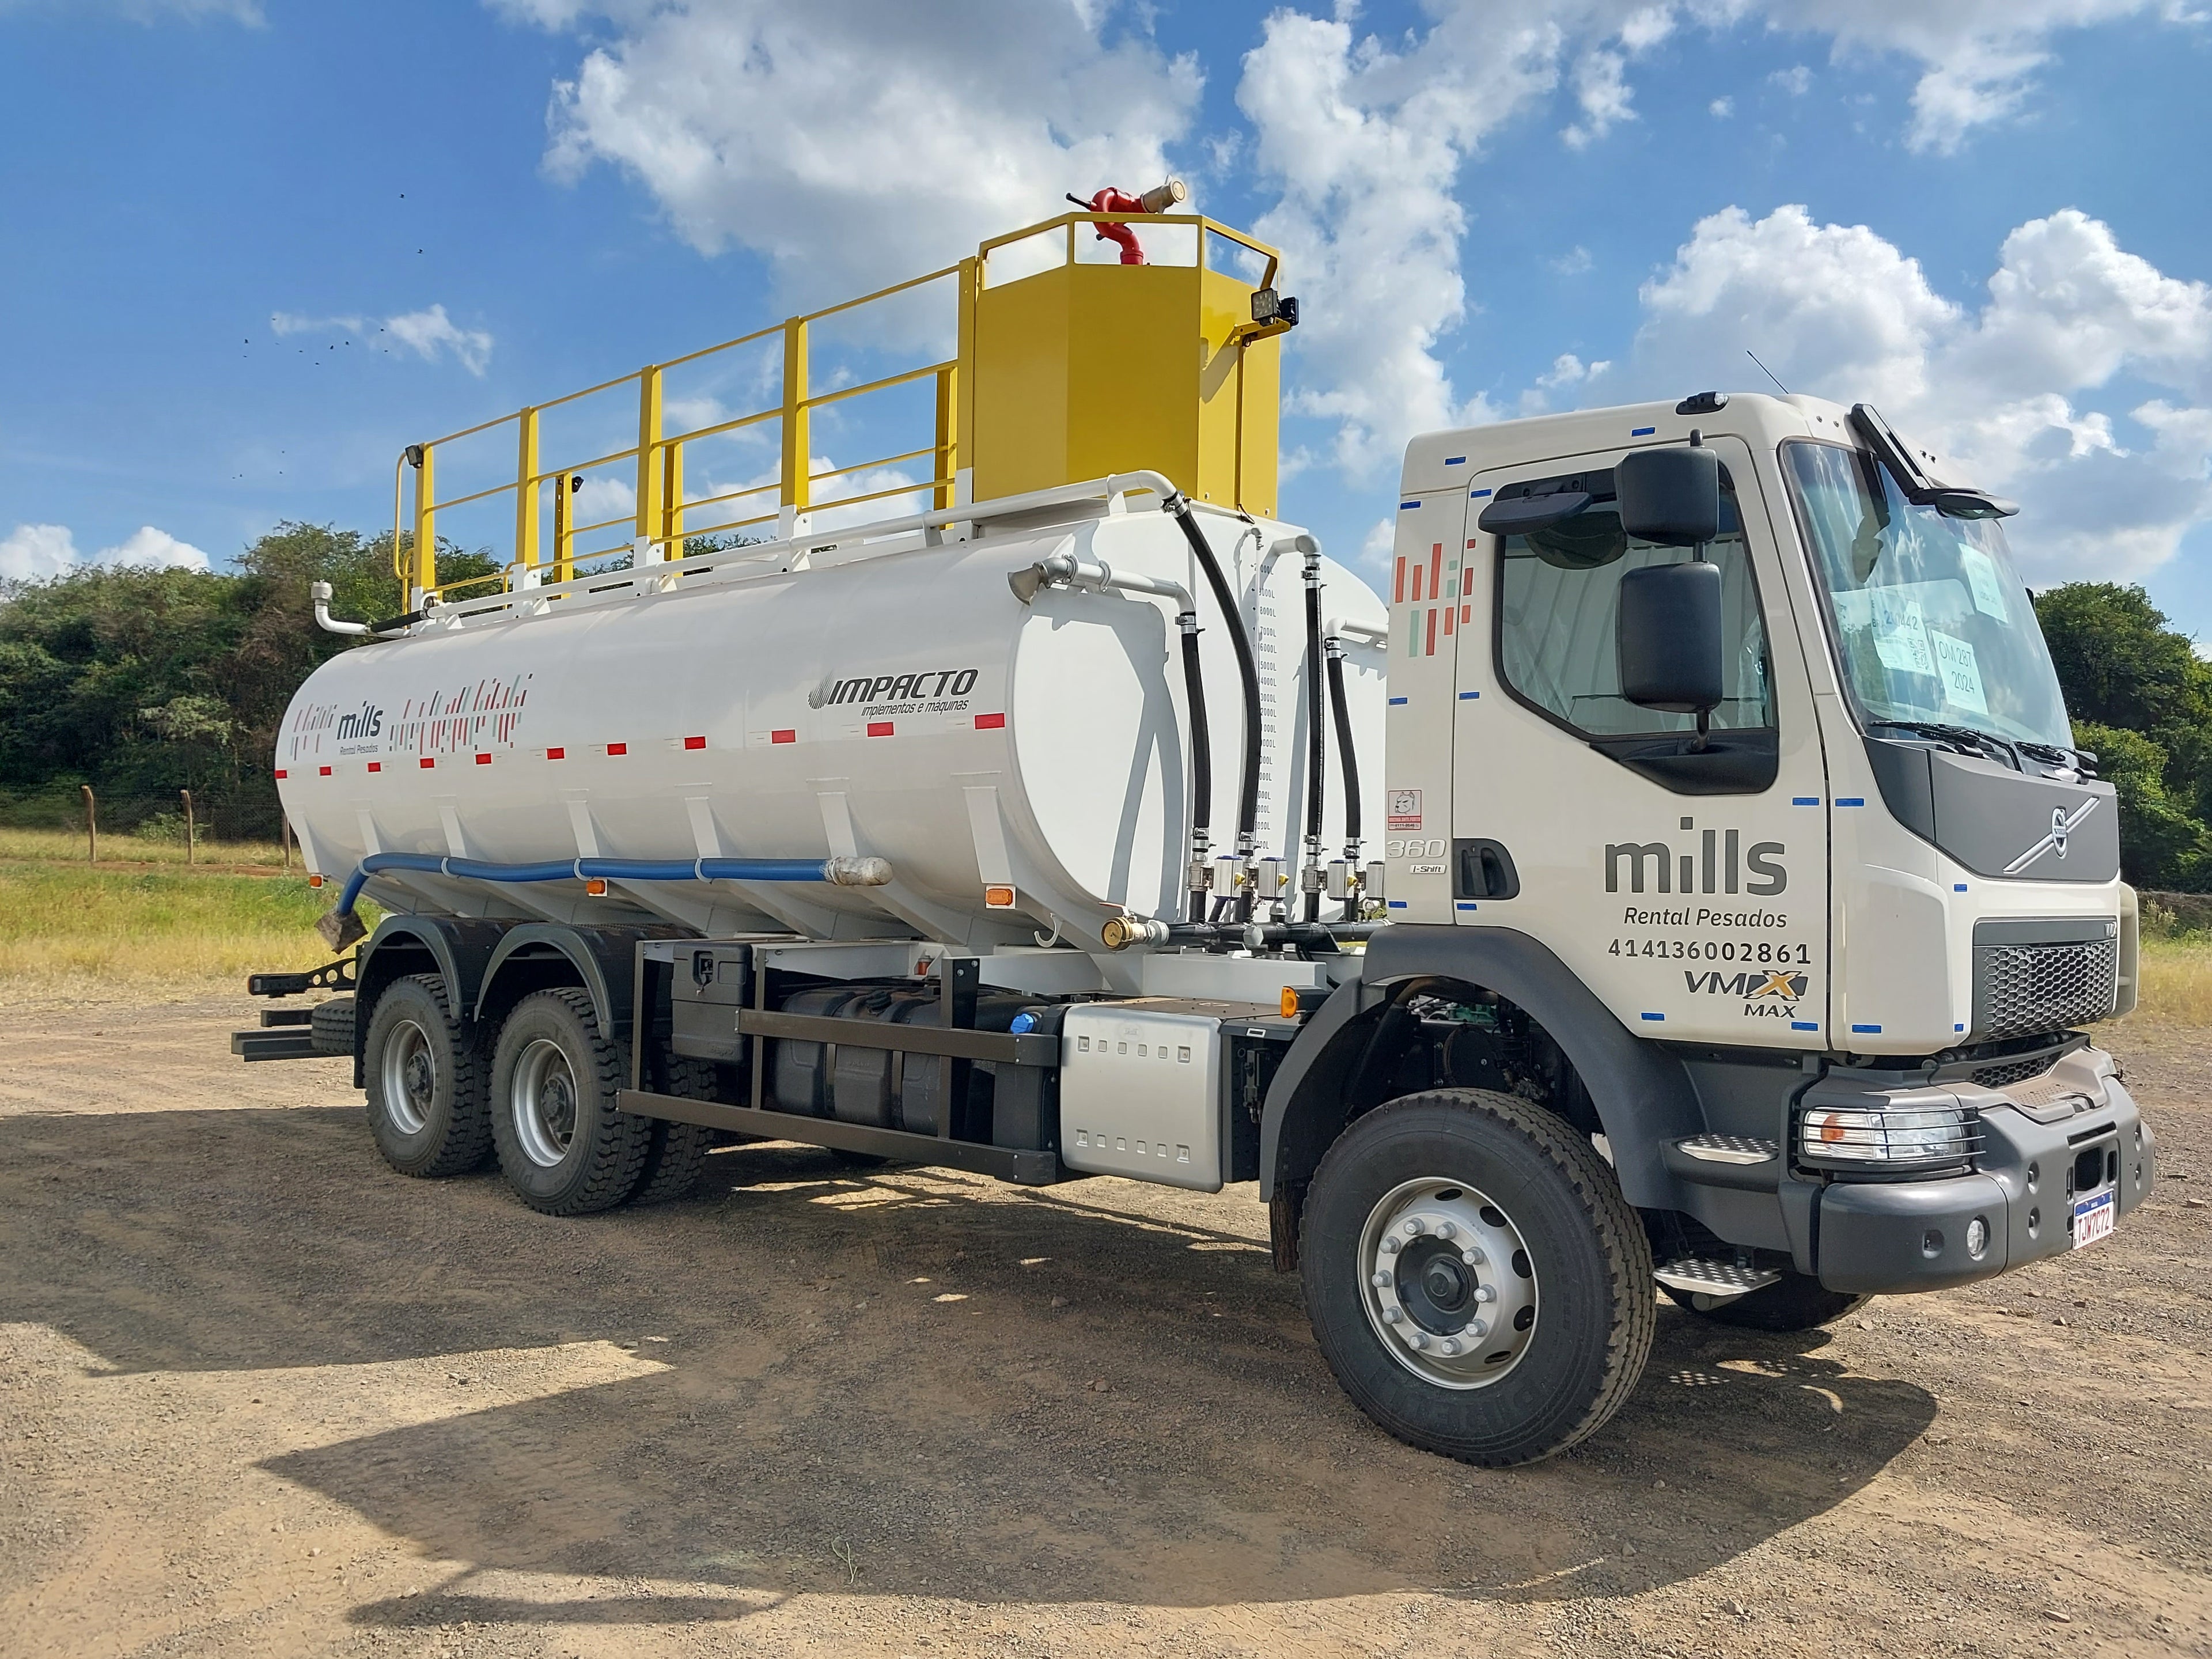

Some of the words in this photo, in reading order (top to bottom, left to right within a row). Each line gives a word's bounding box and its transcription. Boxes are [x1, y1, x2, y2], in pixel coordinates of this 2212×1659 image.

[1939, 641, 1956, 662] OM
[1956, 647, 1972, 668] 287
[827, 668, 979, 705] IMPACTO
[1951, 671, 1975, 694] 2024
[861, 700, 915, 719] implementos
[917, 702, 923, 713] e
[925, 699, 969, 715] máquinas
[336, 700, 384, 741] mills
[1263, 724, 1277, 733] 000L
[1263, 739, 1276, 748] 000L
[1260, 756, 1272, 764] 000L
[1259, 772, 1272, 781] 000L
[1257, 790, 1271, 800] 000L
[1387, 839, 1446, 858] 360
[1605, 816, 1787, 896] mills
[1623, 906, 1691, 926] Rental
[1696, 908, 1788, 928] Pesados
[1608, 938, 1811, 965] 414136002861
[1743, 1003, 1797, 1018] MAX
[2078, 1206, 2110, 1244] TJW7C72
